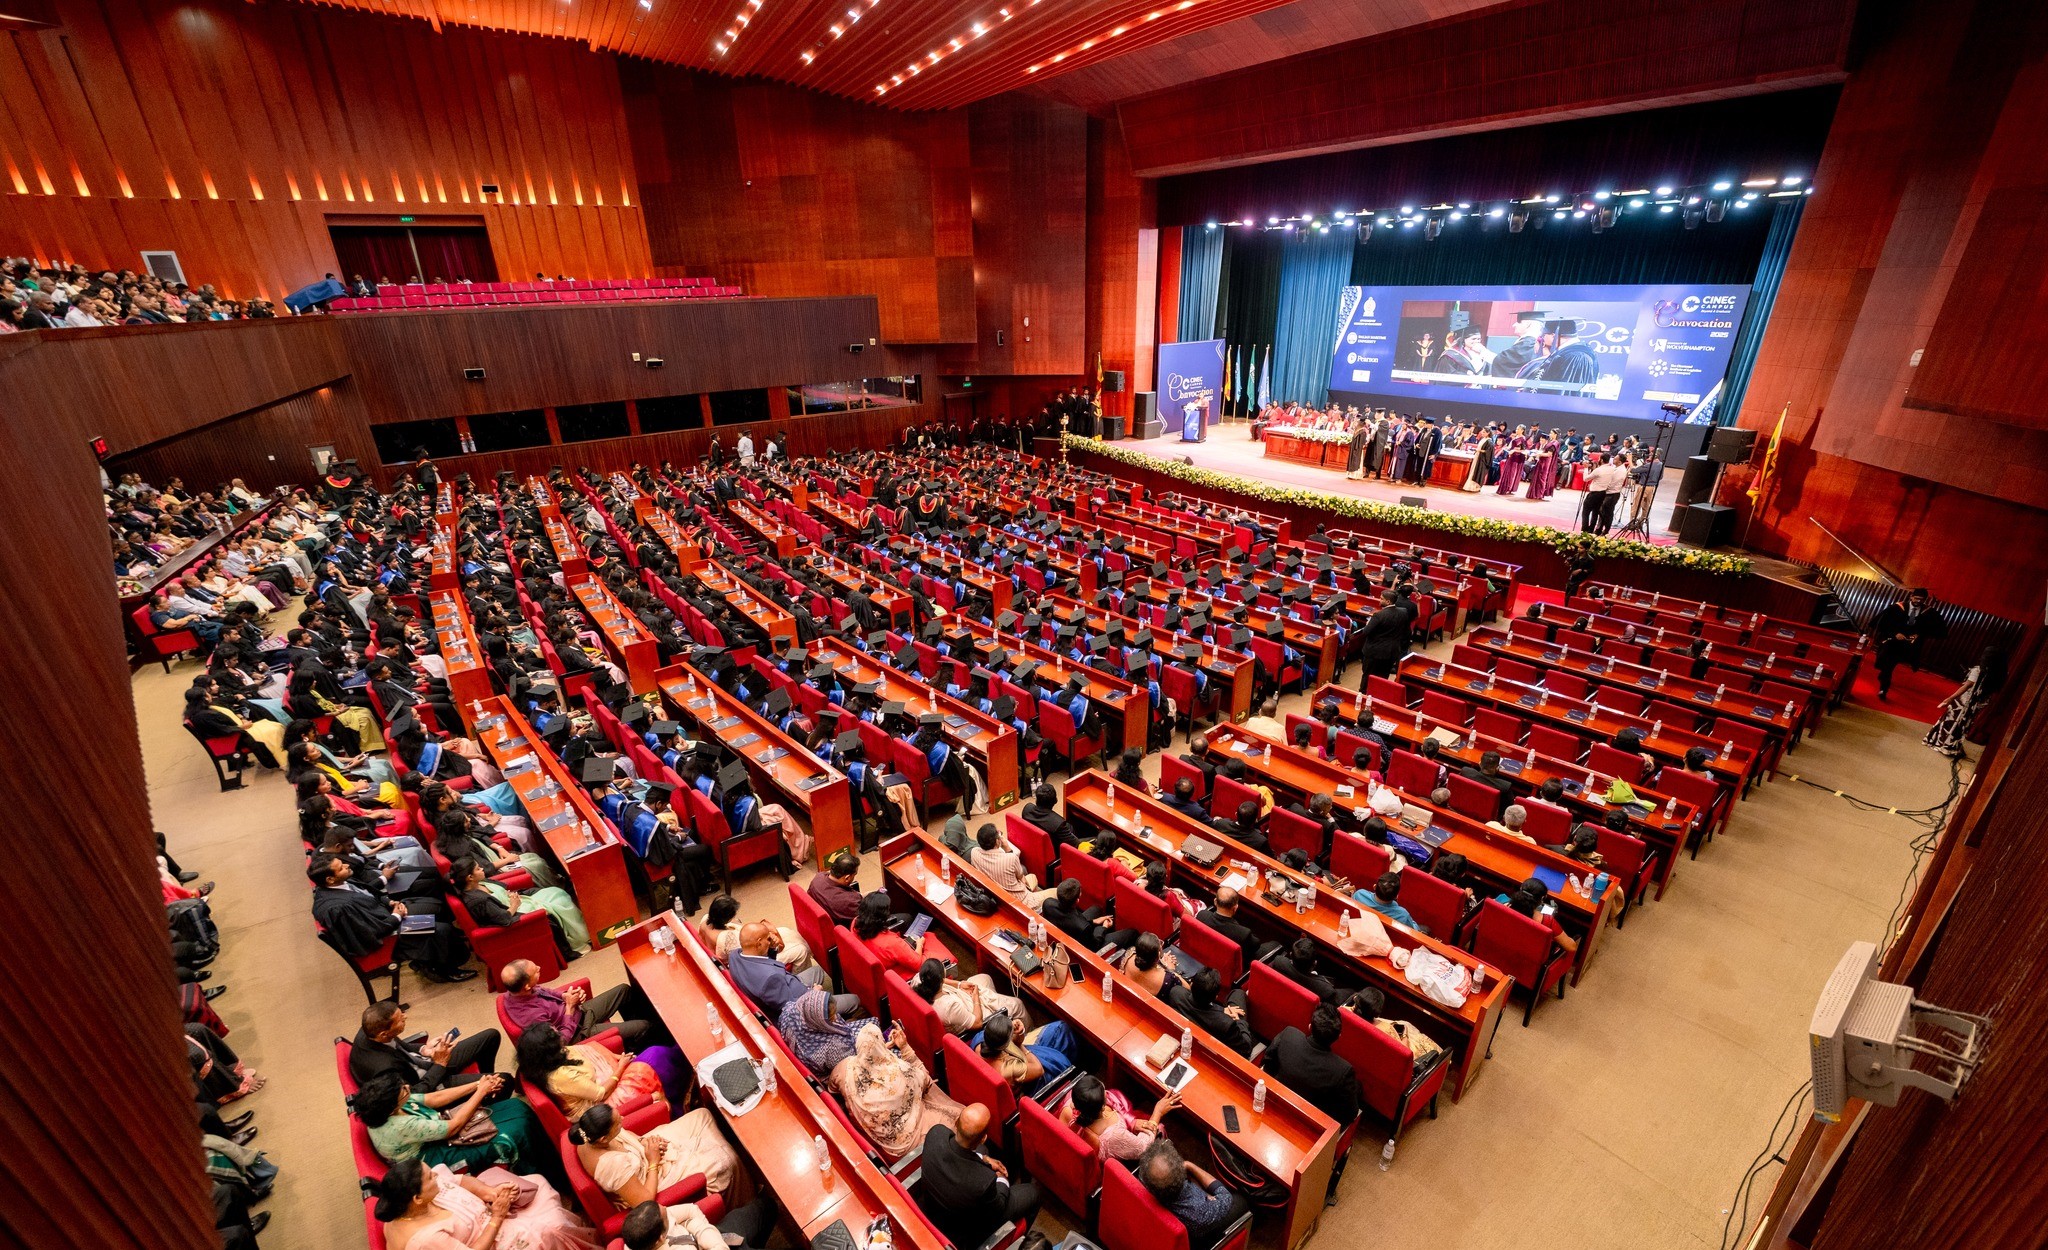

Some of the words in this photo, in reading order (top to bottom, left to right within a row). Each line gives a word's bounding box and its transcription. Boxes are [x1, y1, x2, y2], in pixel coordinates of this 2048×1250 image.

[1702, 296, 1736, 304] CINEC
[1666, 344, 1715, 352] WOLVERHAMPTON
[1357, 355, 1379, 363] Pearson
